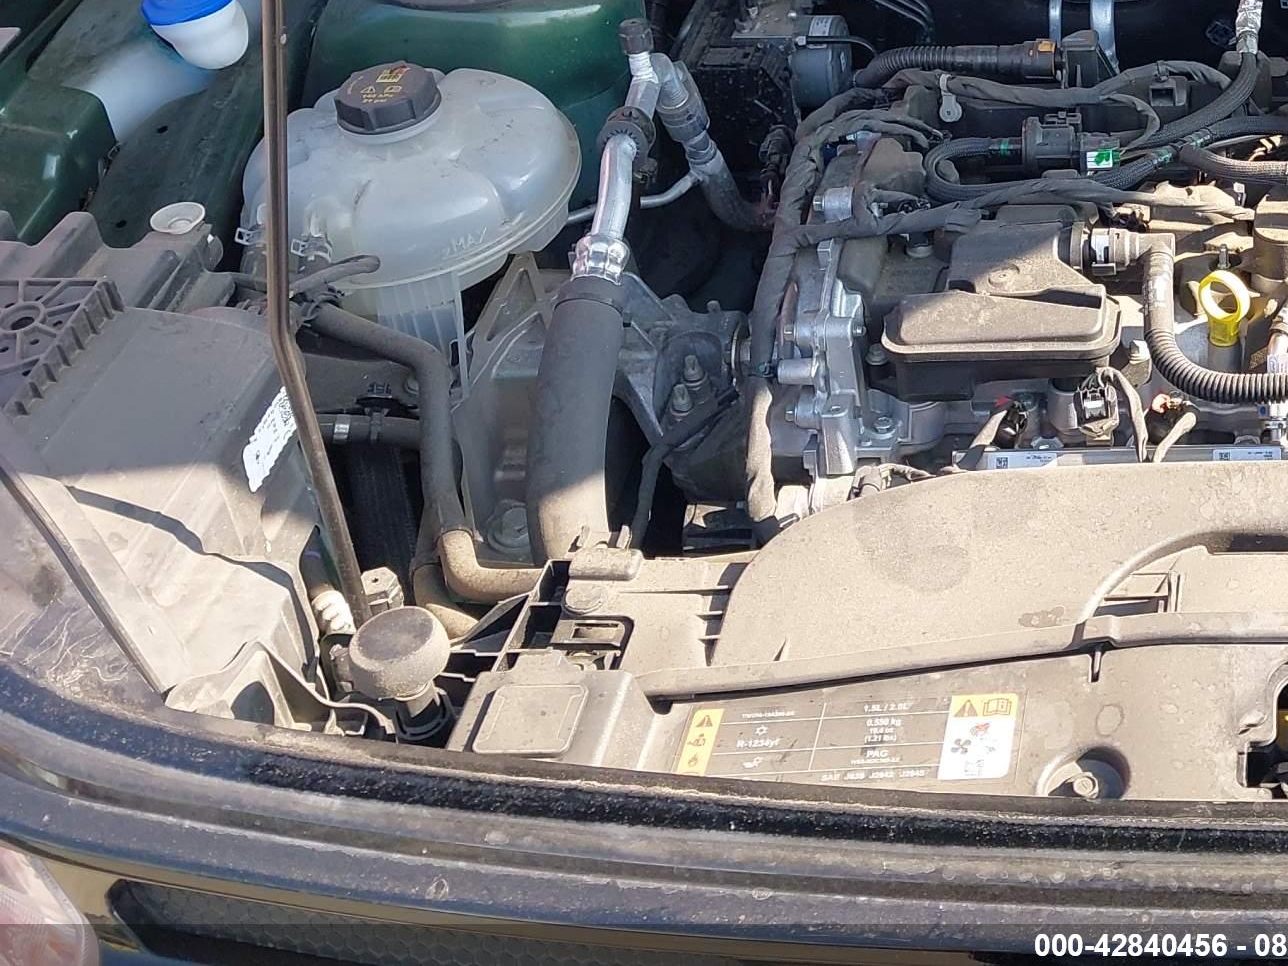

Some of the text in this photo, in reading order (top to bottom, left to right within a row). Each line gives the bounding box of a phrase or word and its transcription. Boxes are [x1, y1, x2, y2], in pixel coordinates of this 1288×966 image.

[890, 717, 902, 727] kg
[736, 738, 781, 749] R-1234yf
[866, 750, 889, 758] PAG
[820, 773, 841, 782] SAE
